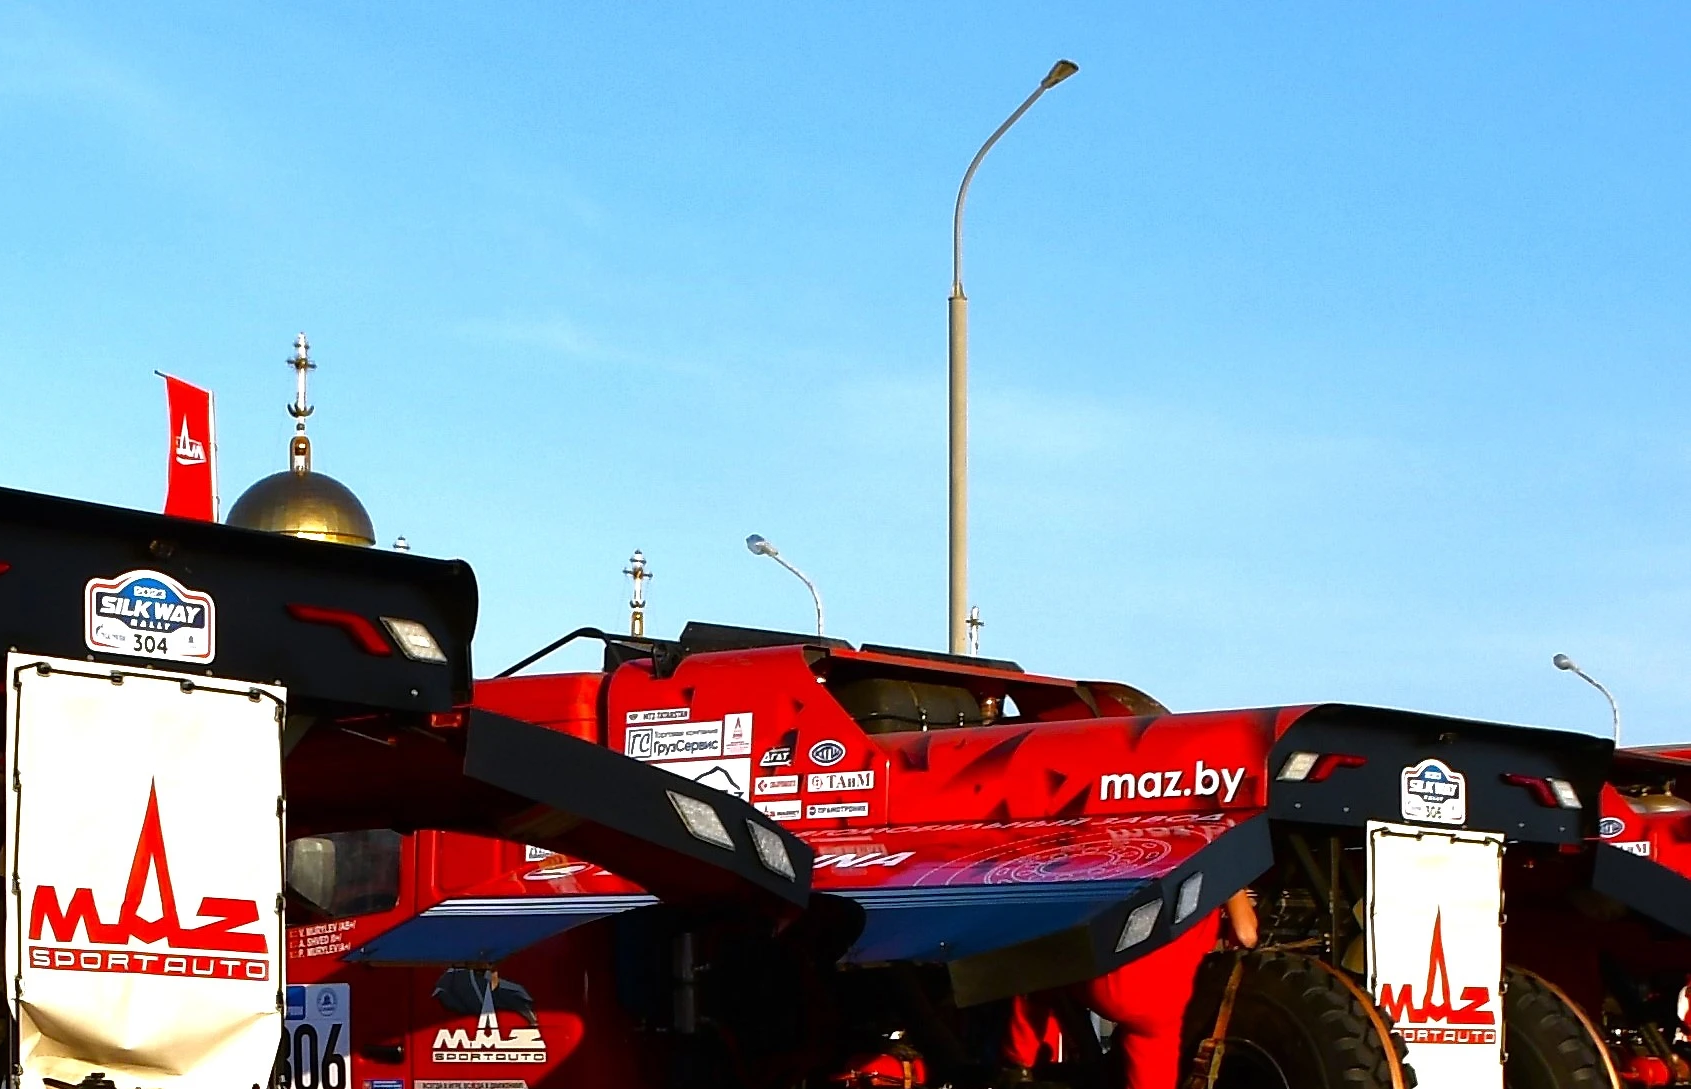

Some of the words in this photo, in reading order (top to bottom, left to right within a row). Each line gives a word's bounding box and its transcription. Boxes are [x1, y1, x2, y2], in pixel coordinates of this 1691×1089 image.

[100, 596, 152, 618] SILK
[154, 601, 201, 624] WAY
[133, 633, 168, 654] 304
[654, 740, 719, 756] ГрузСервис
[1099, 760, 1246, 803] maz.by
[29, 774, 269, 954] MAZ
[32, 949, 267, 979] SPORTAUTO
[1379, 904, 1495, 1025] MAZ
[434, 1053, 545, 1062] SPORTAUTO
